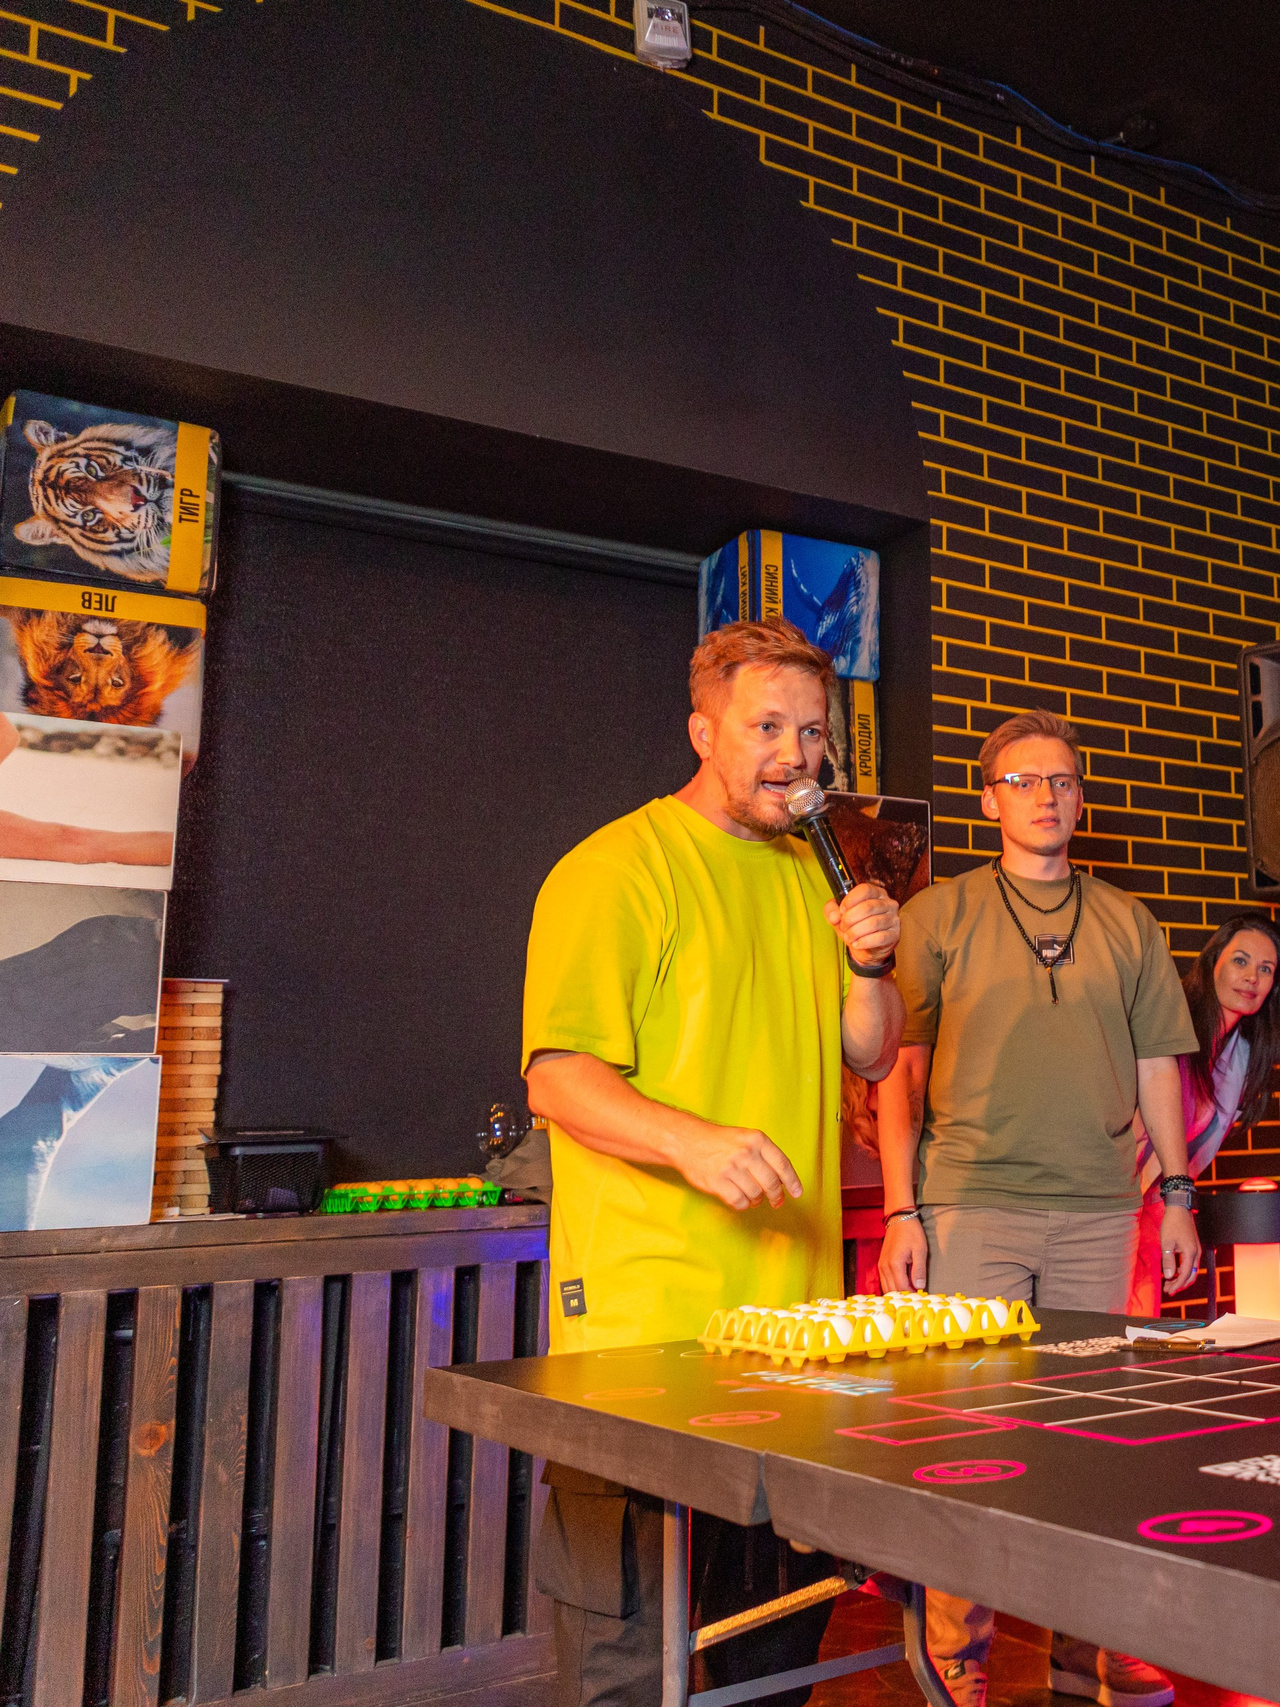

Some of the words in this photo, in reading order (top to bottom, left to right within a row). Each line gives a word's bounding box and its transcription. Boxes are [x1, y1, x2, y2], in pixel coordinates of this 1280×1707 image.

[653, 23, 679, 33] FIRE
[179, 488, 200, 523] ТИГР
[81, 591, 117, 612] ЛЕВ
[764, 564, 781, 604] СИНИЙ
[858, 713, 873, 777] КРОКОДИЛ
